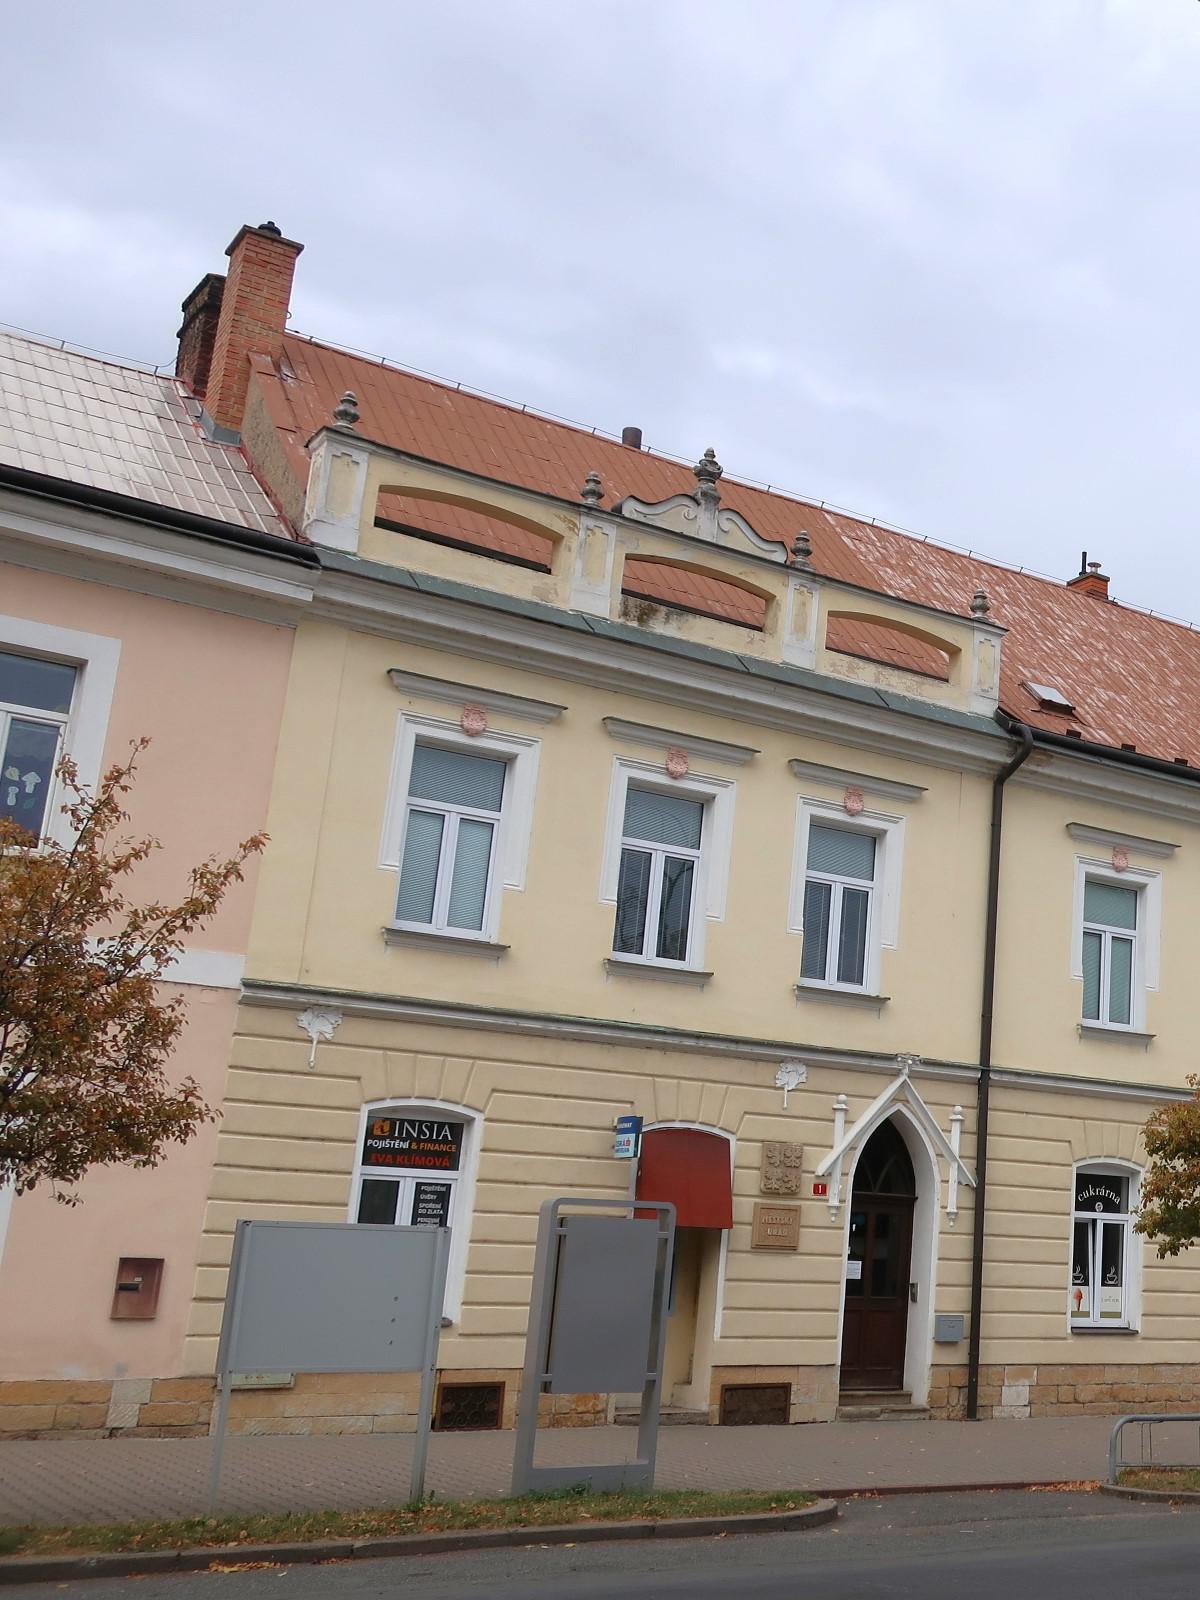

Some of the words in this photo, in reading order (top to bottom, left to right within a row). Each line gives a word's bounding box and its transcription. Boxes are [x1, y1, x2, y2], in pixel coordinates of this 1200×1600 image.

[394, 1120, 452, 1140] INSIA
[367, 1139, 410, 1149] POJIŠTĚNÍ
[411, 1141, 418, 1149] &
[420, 1142, 457, 1152] FINANCE
[371, 1153, 393, 1163] EVA
[397, 1153, 450, 1166] KLÍMOVÁ
[1078, 1184, 1121, 1205] cukrárna
